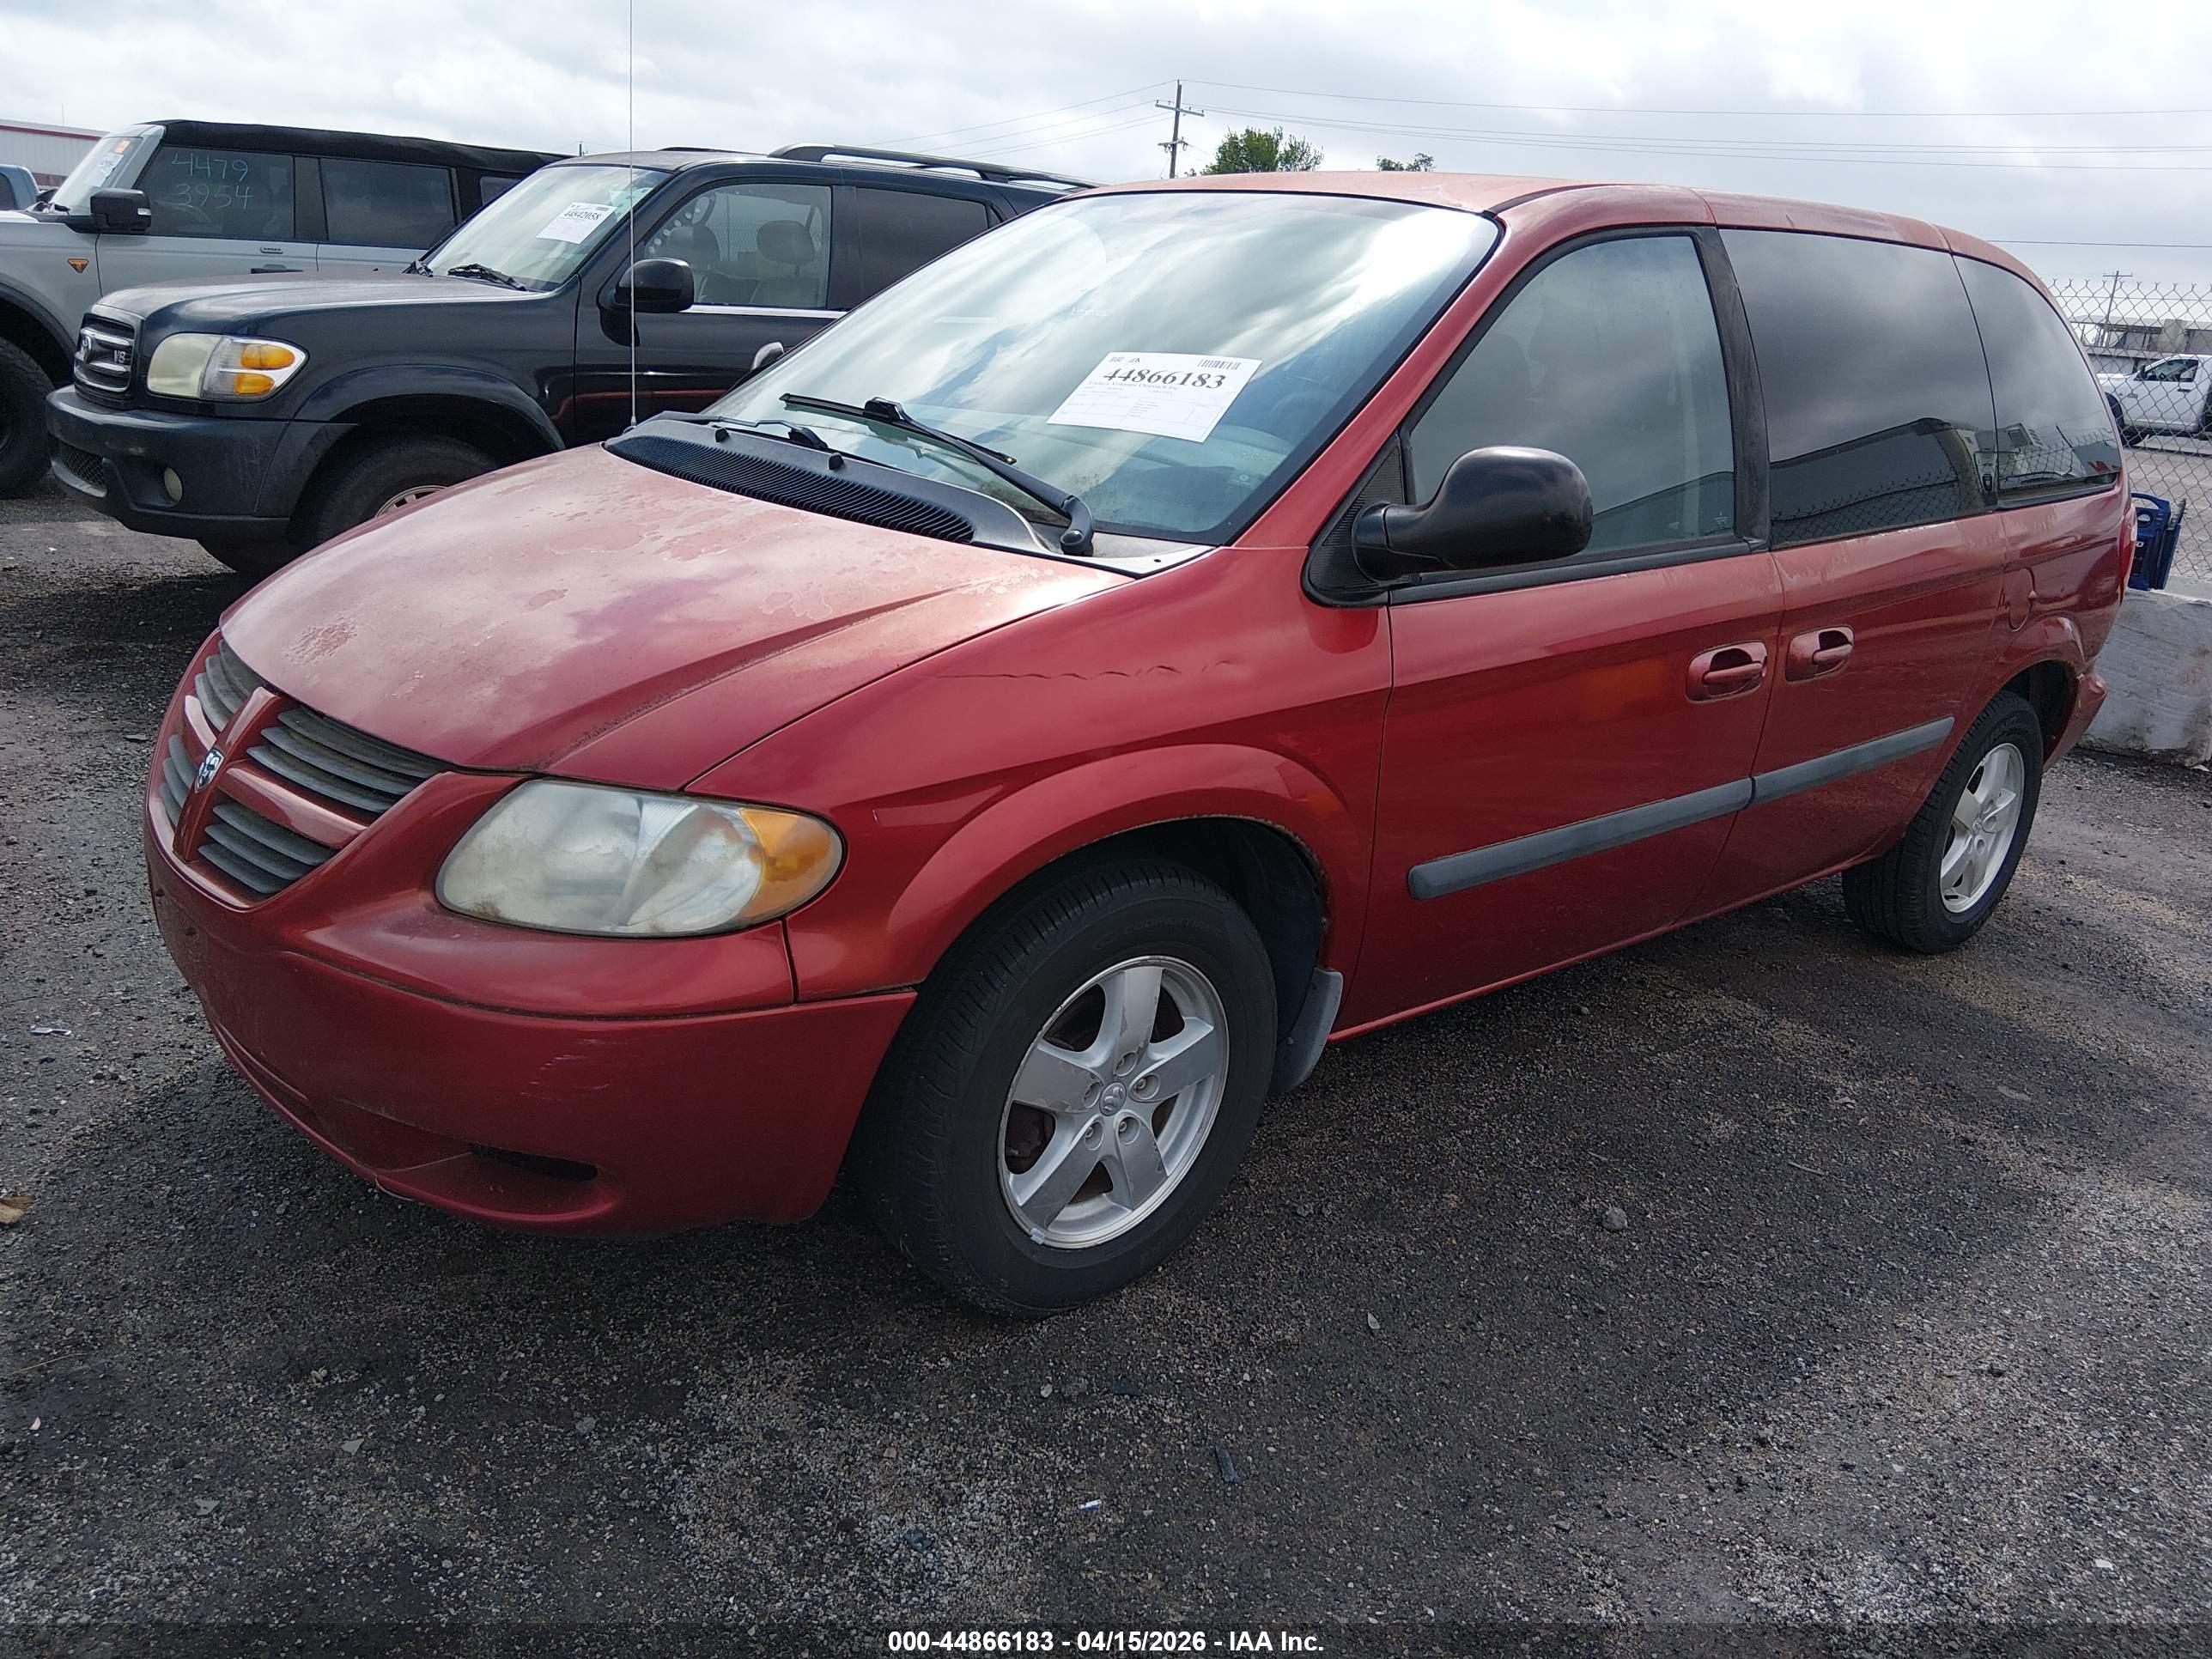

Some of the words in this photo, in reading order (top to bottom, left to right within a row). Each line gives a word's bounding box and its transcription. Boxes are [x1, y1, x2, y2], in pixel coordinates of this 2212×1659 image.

[171, 153, 248, 182] 4479
[175, 183, 253, 210] 3954
[113, 349, 126, 363] V8
[1103, 368, 1226, 389] 44866183
